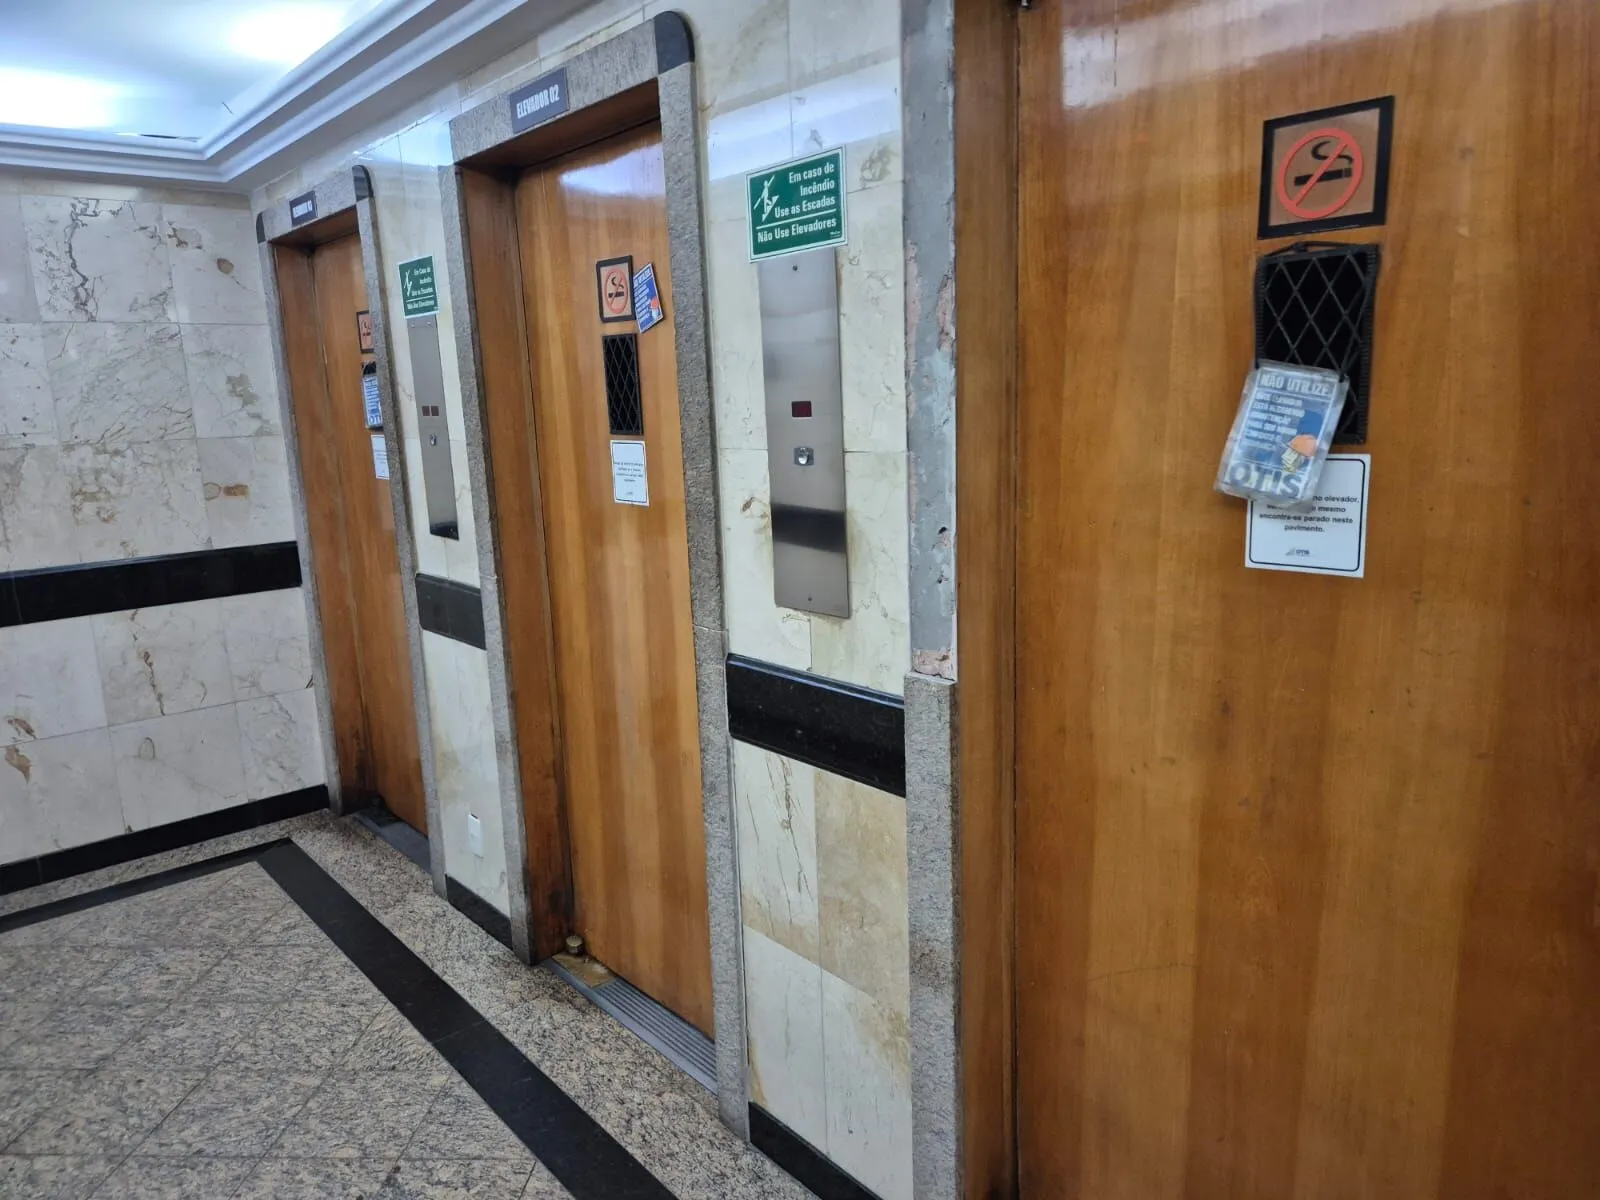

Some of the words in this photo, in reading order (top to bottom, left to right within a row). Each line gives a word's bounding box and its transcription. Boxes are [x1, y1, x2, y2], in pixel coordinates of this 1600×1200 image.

[516, 89, 549, 119] ELEVADOR
[549, 84, 560, 104] 02
[788, 171, 802, 184] Em
[803, 166, 822, 180] caso
[824, 162, 835, 174] de
[800, 178, 835, 197] Incêndio
[774, 206, 789, 219] Use
[791, 205, 801, 215] as
[802, 195, 836, 212] Escadas
[757, 230, 772, 243] Não
[774, 227, 789, 239] Use
[791, 218, 837, 236] Elevadores
[1261, 373, 1284, 389] NÃO
[1286, 377, 1330, 397] UTILIZE
[1229, 462, 1302, 499] OTIS
[1259, 513, 1302, 521] encontra-se
[1303, 515, 1330, 523] parado
[1284, 524, 1326, 533] pavimento.
